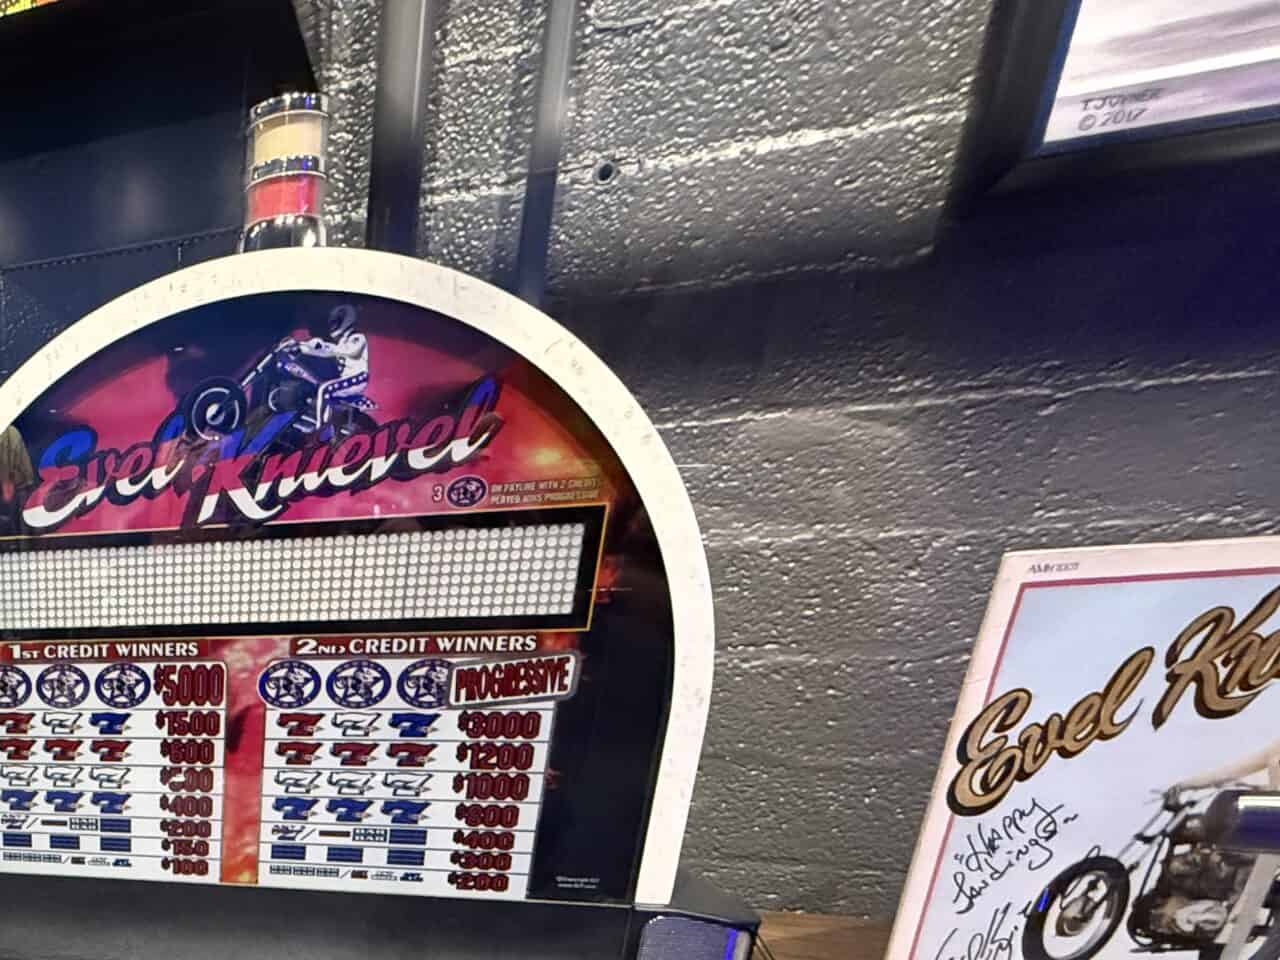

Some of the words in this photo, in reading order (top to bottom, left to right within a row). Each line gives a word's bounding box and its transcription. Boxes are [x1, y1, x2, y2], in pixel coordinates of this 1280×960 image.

[22, 414, 187, 527] Evel
[195, 372, 505, 525] Knievel
[432, 484, 444, 502] 3
[8, 643, 39, 660] 1ST
[44, 643, 109, 659] CREDIT
[116, 642, 200, 658] WINNERS
[348, 636, 430, 654] CREDIT
[437, 634, 538, 651] WINNERS
[153, 663, 225, 707] $5000
[454, 656, 571, 702] PROGRESSIVE
[155, 710, 221, 737] $1500
[457, 710, 542, 739] $3000
[946, 646, 1156, 817] Evel
[160, 738, 215, 764] $600
[456, 741, 535, 770] $1200
[452, 773, 531, 801] $1000
[160, 794, 213, 818] $400
